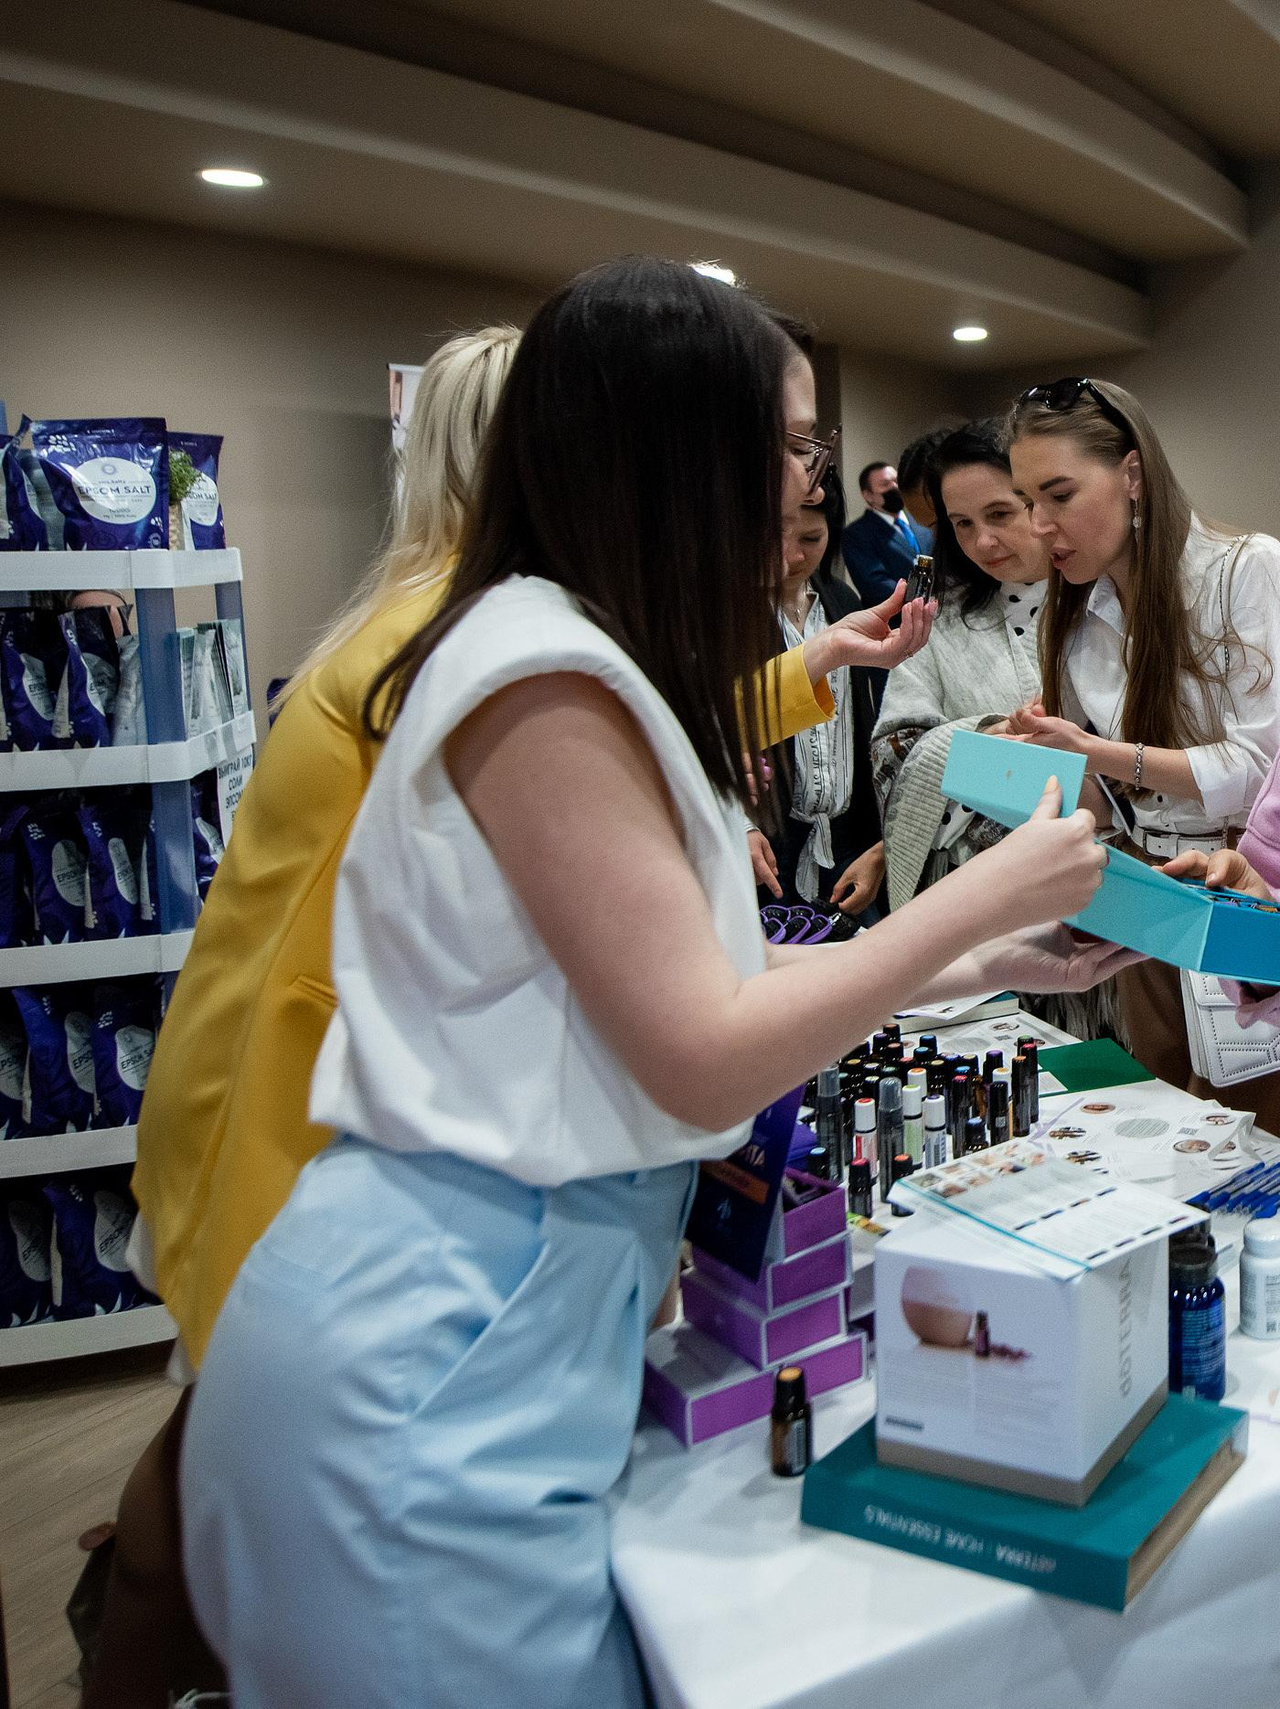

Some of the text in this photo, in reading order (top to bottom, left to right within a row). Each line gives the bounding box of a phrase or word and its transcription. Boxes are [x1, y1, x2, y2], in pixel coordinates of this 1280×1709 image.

[123, 485, 152, 494] SALT
[809, 738, 820, 770] VEGAS
[864, 1504, 942, 1545] ESSENTIALS
[945, 1527, 985, 1553] HOME
